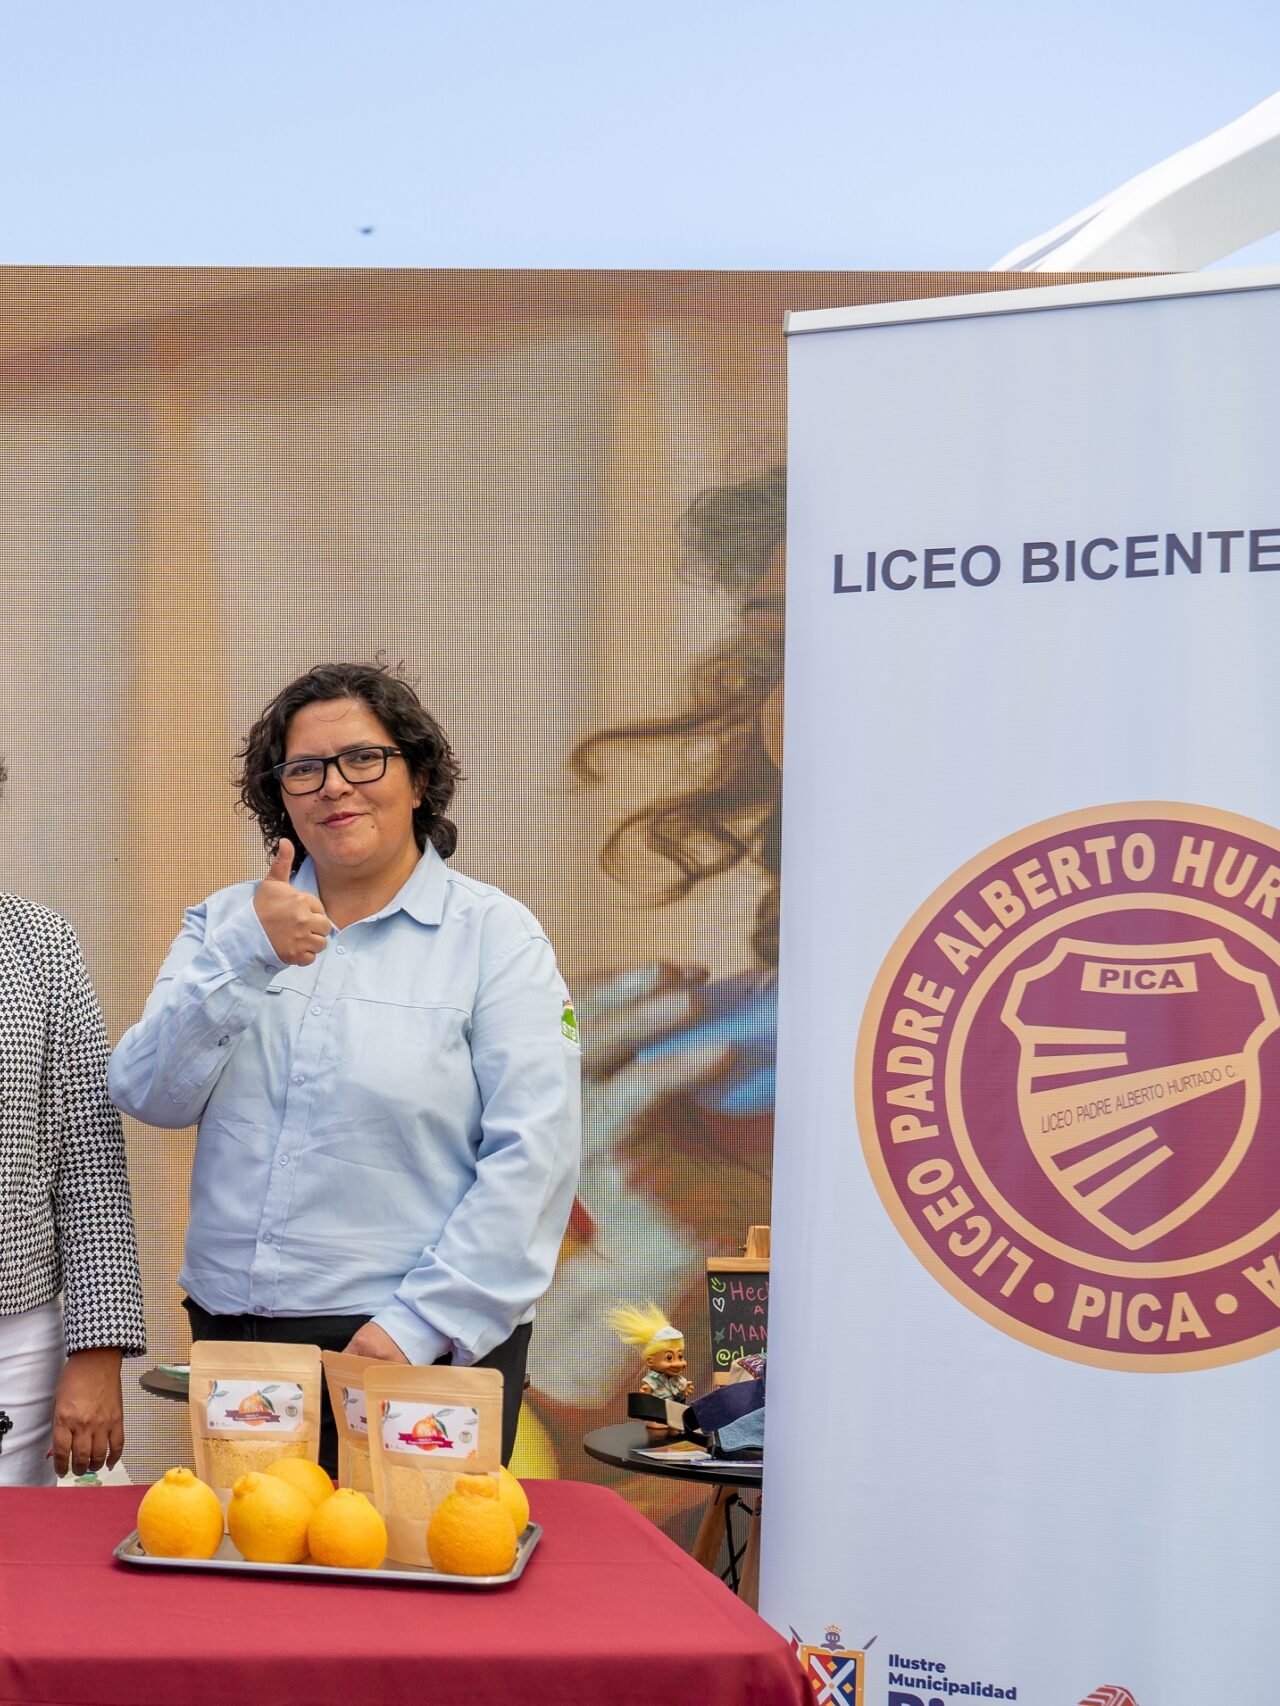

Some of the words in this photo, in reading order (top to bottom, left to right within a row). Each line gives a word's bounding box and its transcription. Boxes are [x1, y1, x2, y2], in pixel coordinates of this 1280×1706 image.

[833, 544, 1002, 594] LICEO
[1021, 528, 1280, 584] BICENTE
[933, 832, 1156, 976] ALBERTO
[1098, 967, 1185, 990] PICA
[885, 971, 956, 1145] PADRE
[1041, 1109, 1073, 1134] LICEO
[1076, 1098, 1113, 1124] PADRE
[1115, 1083, 1164, 1112] ALBERTO
[1166, 1067, 1223, 1096] HURTADO
[1224, 1064, 1239, 1079] C.
[906, 1158, 1035, 1299] LICEO
[1067, 1283, 1212, 1343] PICA
[888, 1654, 946, 1674] Ilustre
[888, 1671, 1017, 1701] Municipalidad
